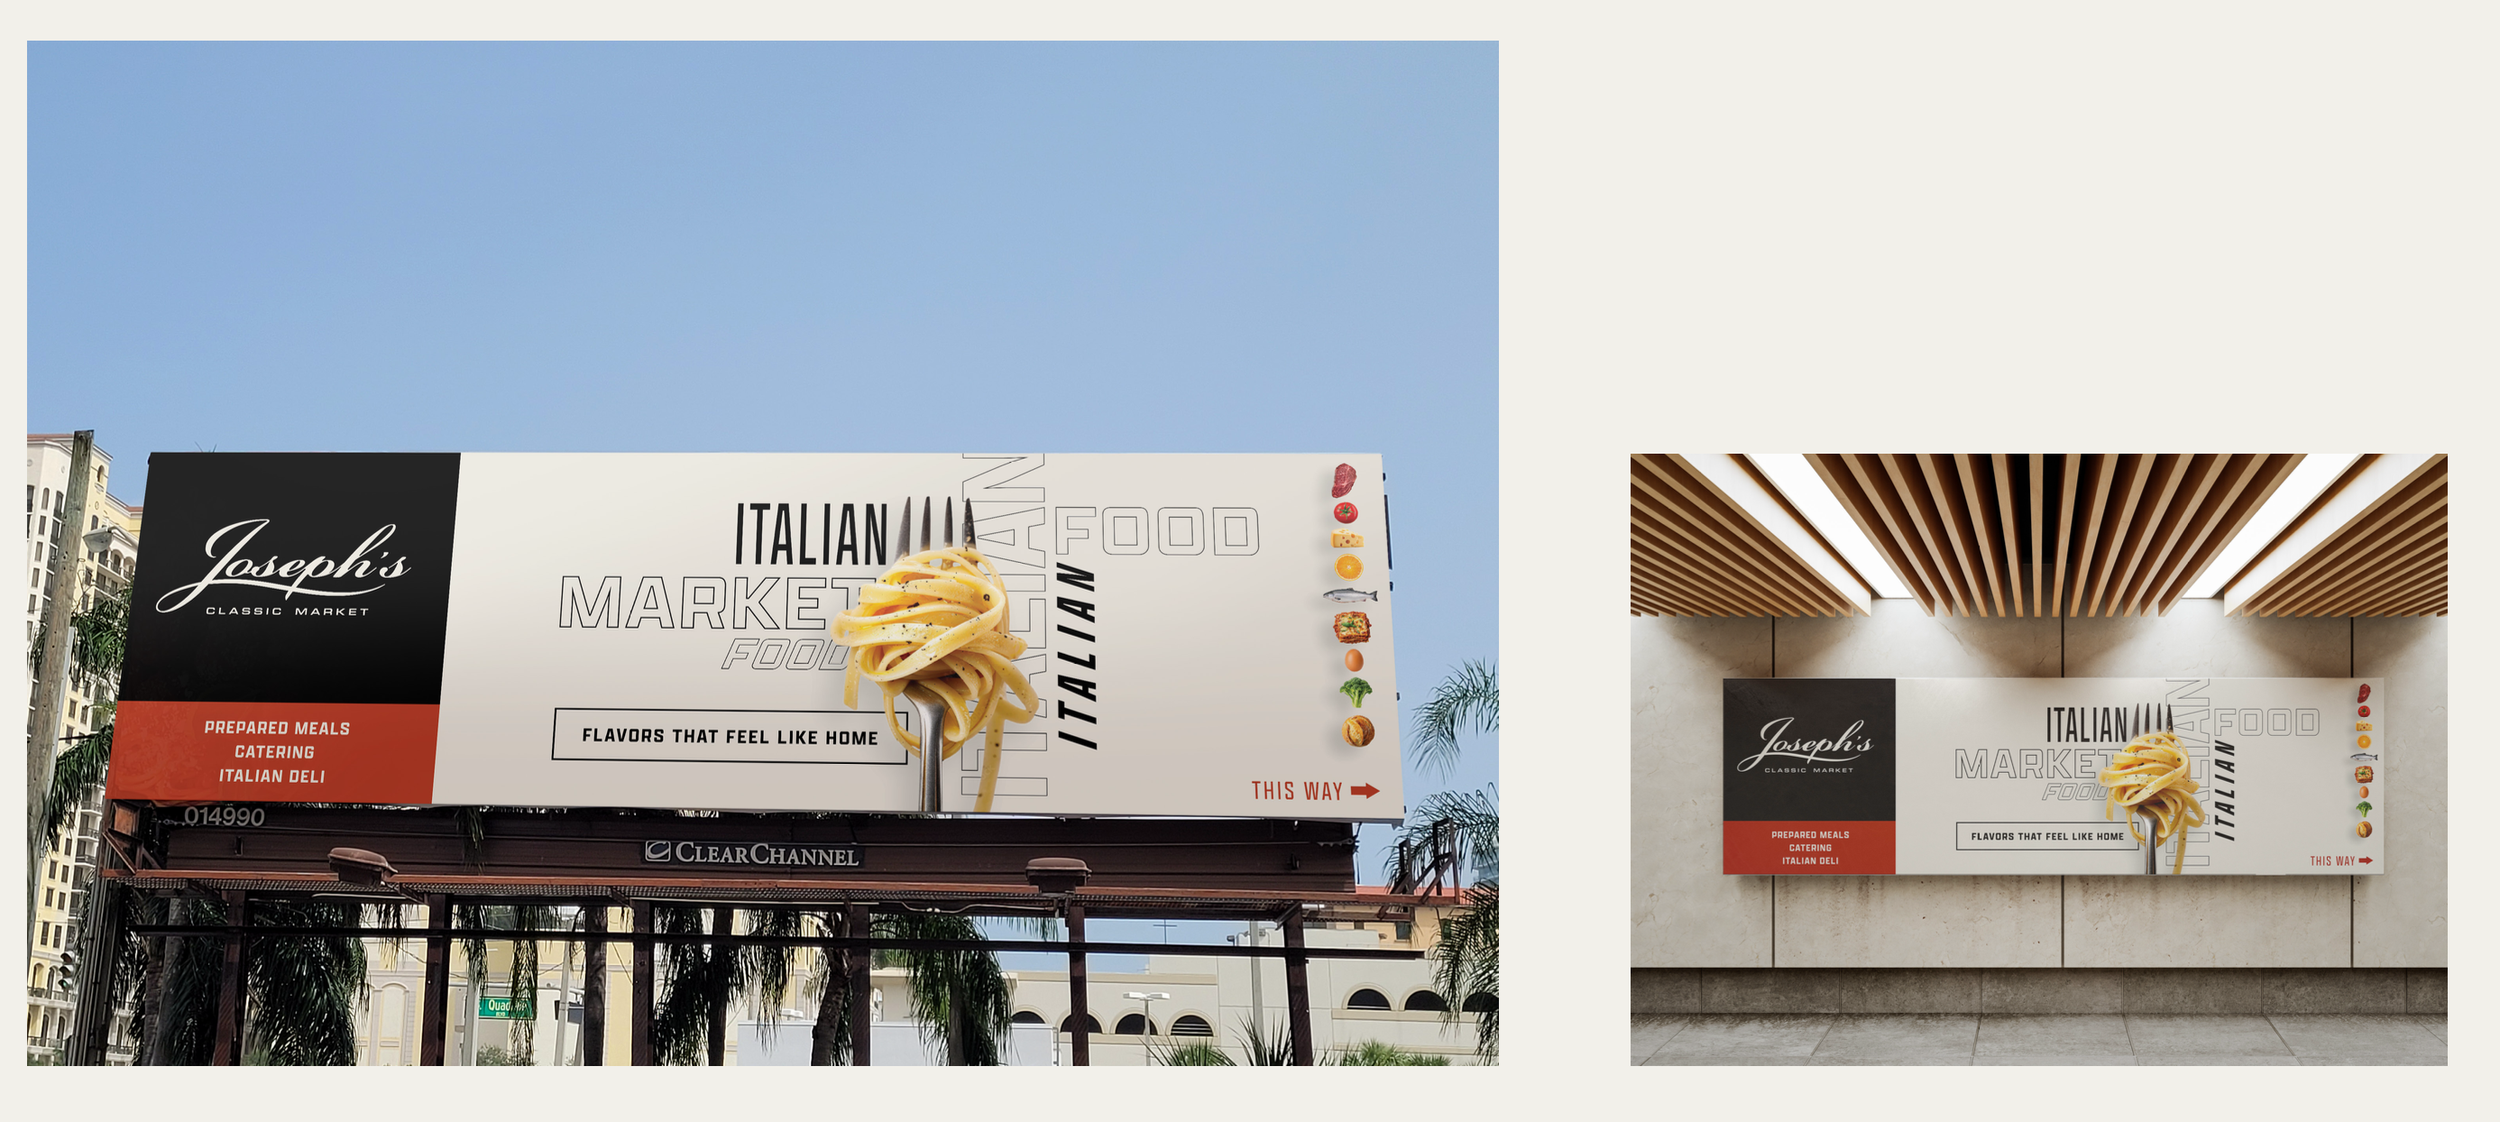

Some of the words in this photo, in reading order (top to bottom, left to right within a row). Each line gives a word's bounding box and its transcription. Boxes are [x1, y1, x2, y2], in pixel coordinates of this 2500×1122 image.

[735, 502, 887, 565] ITALIAN
[1055, 506, 1260, 556] FOOD
[155, 518, 412, 613] Joseph's
[205, 606, 282, 616] CLASSIC
[295, 607, 369, 617] MARKET
[559, 575, 877, 630] MARKET
[721, 637, 850, 671] FOOD
[1056, 561, 1098, 751] ITALIAN
[204, 720, 289, 735] PREPARED
[294, 721, 351, 736] MEALS
[2046, 707, 2128, 743] ITALIAN
[2214, 708, 2320, 737] FOOD
[582, 727, 665, 743] FLAVORS
[672, 728, 719, 744] THAT
[726, 729, 769, 745] FEEL
[777, 731, 818, 745] LIKE
[826, 731, 879, 746] HOME
[1737, 716, 1874, 772] Joseph's
[234, 744, 315, 760] CATERING
[1954, 748, 2122, 779] MARKET
[219, 768, 283, 783] ITALIAN
[289, 769, 325, 784] DELI
[1251, 780, 1295, 800] THIS
[1303, 781, 1343, 801] WAY
[2041, 782, 2107, 801] FOOD
[2214, 739, 2236, 842] ITALIAN
[184, 806, 265, 827] 014990
[1771, 831, 1817, 839] PREPARED
[1819, 831, 1850, 839] MEALS
[1971, 832, 2014, 841] FLAVORS
[2018, 832, 2042, 841] THAT
[2046, 832, 2069, 841] FEEL
[2072, 832, 2093, 841] LIKE
[2097, 832, 2125, 841] HOME
[1789, 844, 1832, 852] CATERING
[1782, 857, 1816, 865] ITALIAN
[1820, 857, 1839, 865] DELI
[2310, 856, 2333, 866] THIS
[2335, 856, 2356, 866] WAY
